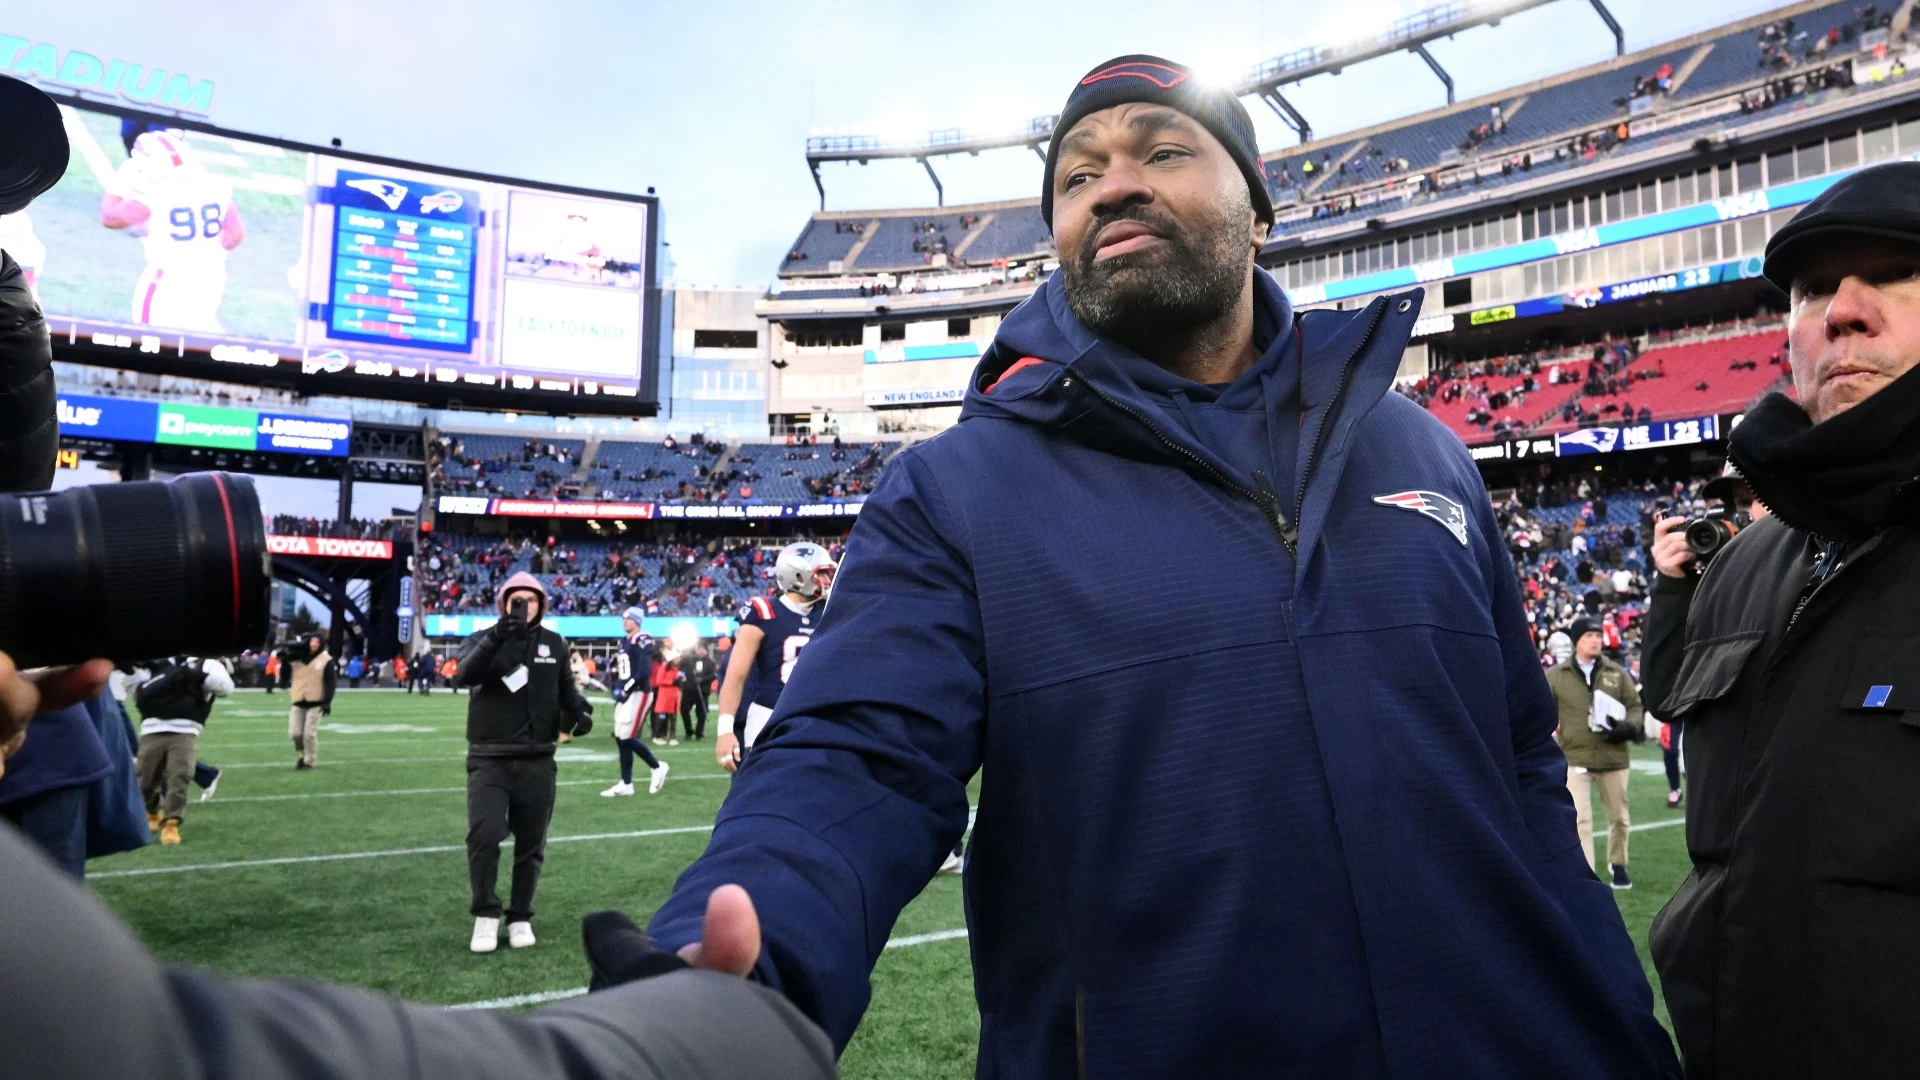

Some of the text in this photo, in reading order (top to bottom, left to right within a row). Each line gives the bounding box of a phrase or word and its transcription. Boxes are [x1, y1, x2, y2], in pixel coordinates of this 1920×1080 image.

[1711, 190, 1769, 219] VISA
[169, 203, 221, 241] 98
[1551, 227, 1600, 254] VISA
[1611, 268, 1711, 300] JAGUARS 23
[884, 393, 906, 402] NEW
[910, 390, 956, 401] ENGLAND
[185, 421, 253, 437] paycom
[1623, 425, 1650, 445] NE
[1674, 420, 1700, 440] 23
[1516, 440, 1530, 458] 7
[554, 504, 597, 515] SPORTS
[660, 505, 782, 517] THE GREG HILL SHOW
[797, 504, 834, 516] JONES
[316, 537, 387, 557] TOYOTA
